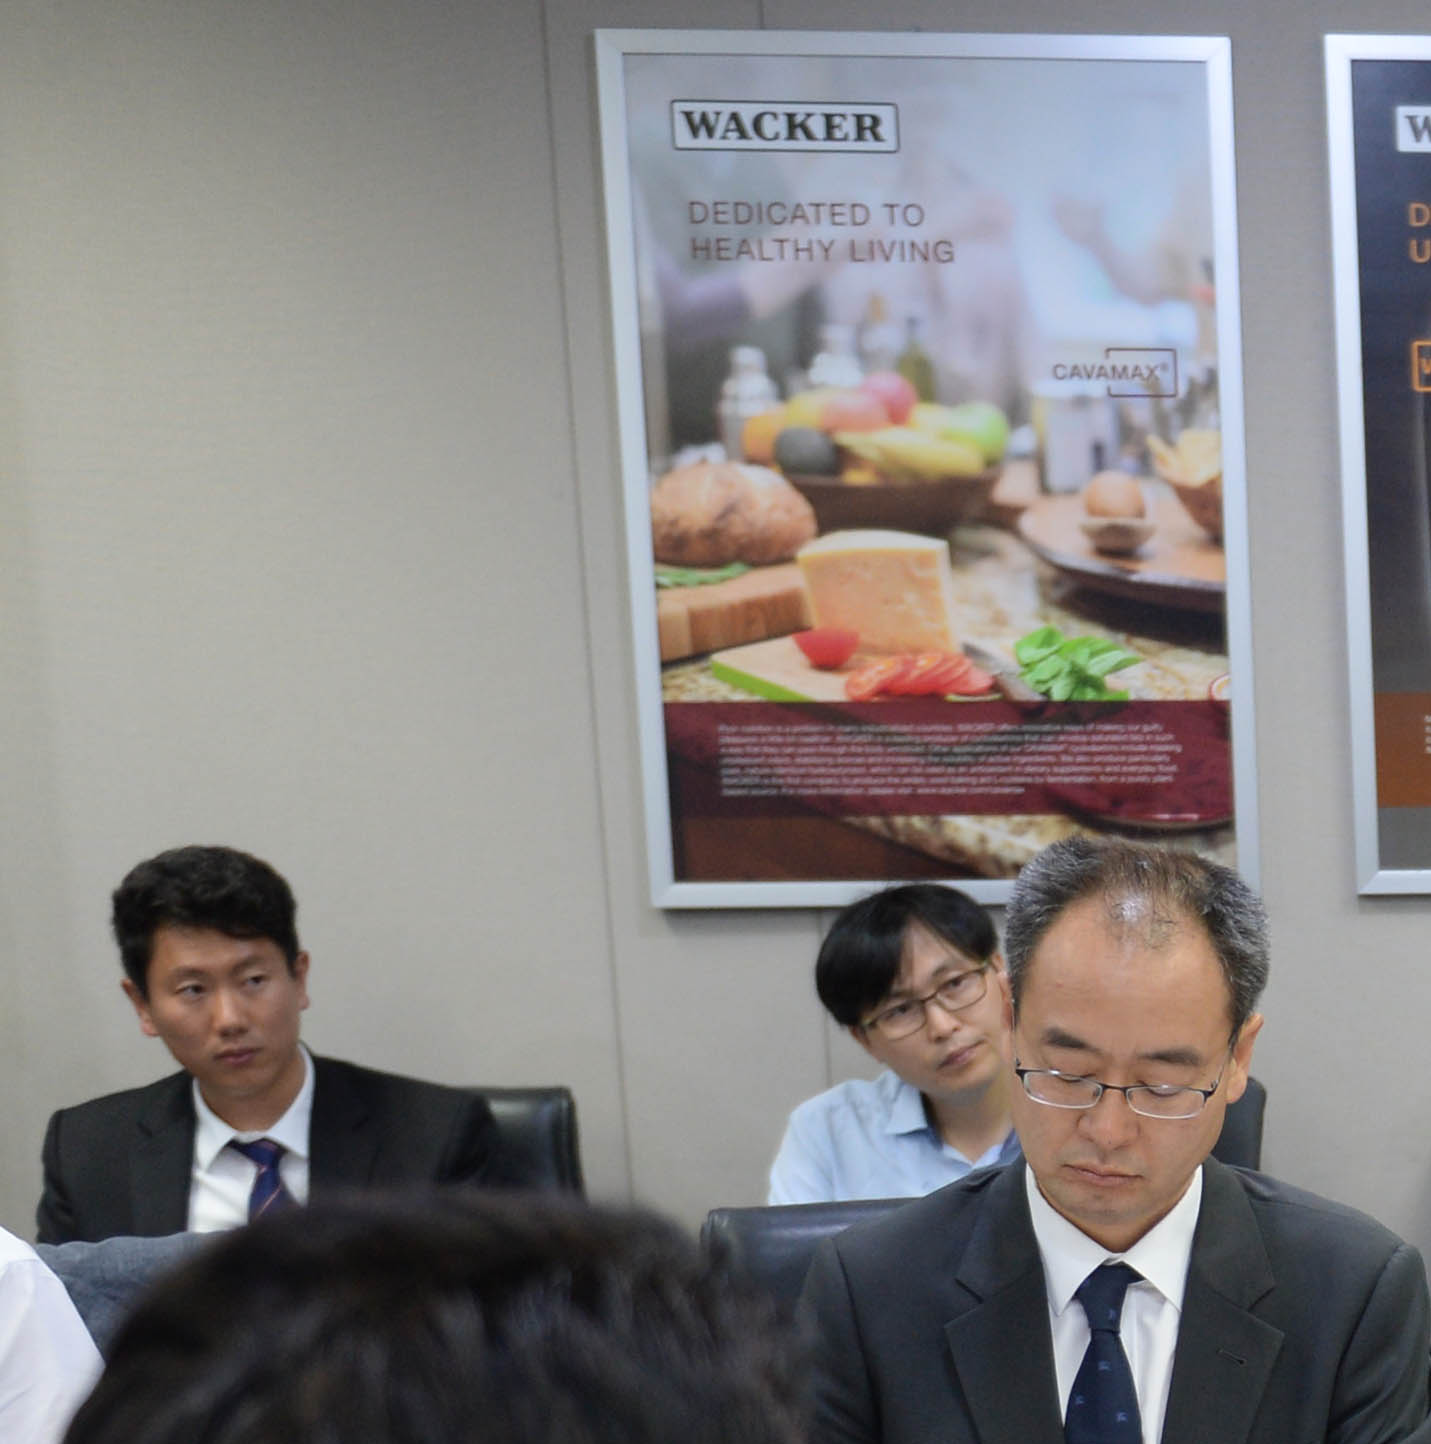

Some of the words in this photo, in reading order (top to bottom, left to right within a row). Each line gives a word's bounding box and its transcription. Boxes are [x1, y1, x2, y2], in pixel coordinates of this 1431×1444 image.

[682, 110, 885, 143] WACKER
[689, 201, 870, 226] DEDICATED
[883, 202, 925, 227] TO
[691, 237, 833, 261] HEALTHY
[849, 239, 955, 264] LIVING
